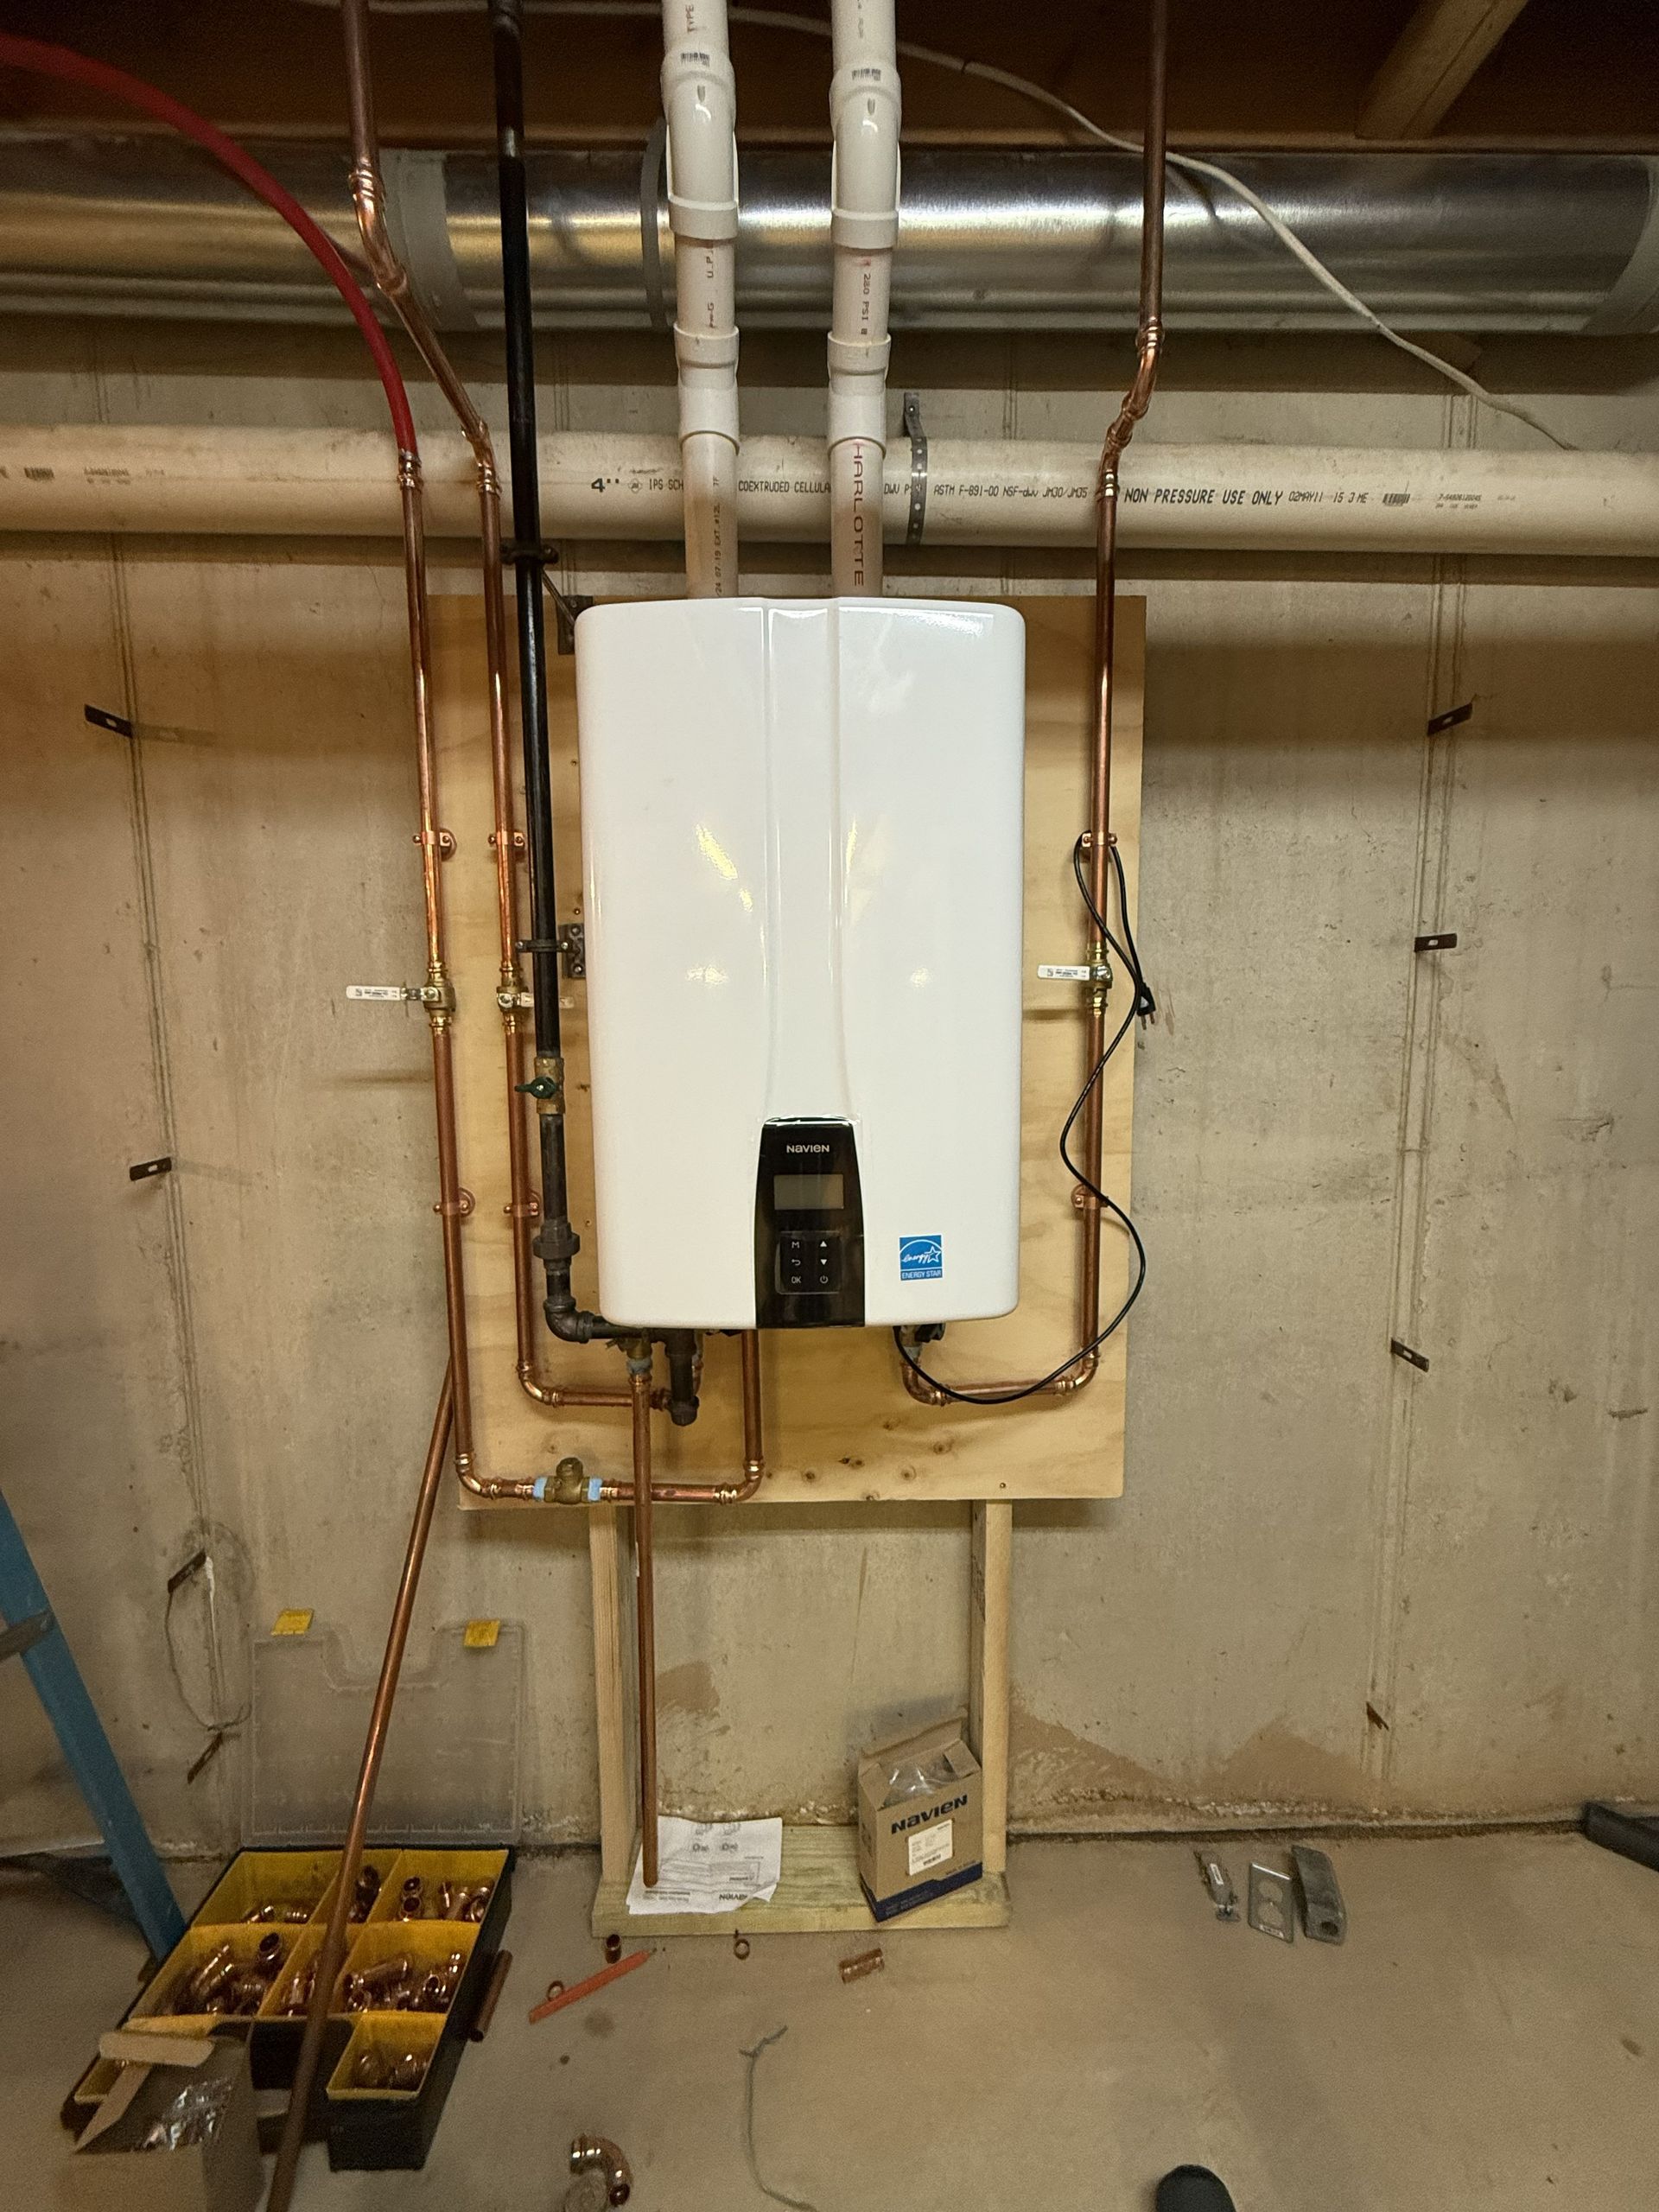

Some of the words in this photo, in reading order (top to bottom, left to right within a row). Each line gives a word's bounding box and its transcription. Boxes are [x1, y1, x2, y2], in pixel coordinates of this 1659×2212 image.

[649, 479, 664, 491] IPS
[668, 479, 684, 491] SCH
[794, 481, 831, 493] CELLULA
[1124, 488, 1149, 503] NON
[1154, 488, 1215, 505] PRESSURE
[1223, 489, 1245, 505] USE
[1252, 490, 1283, 505] ONLY
